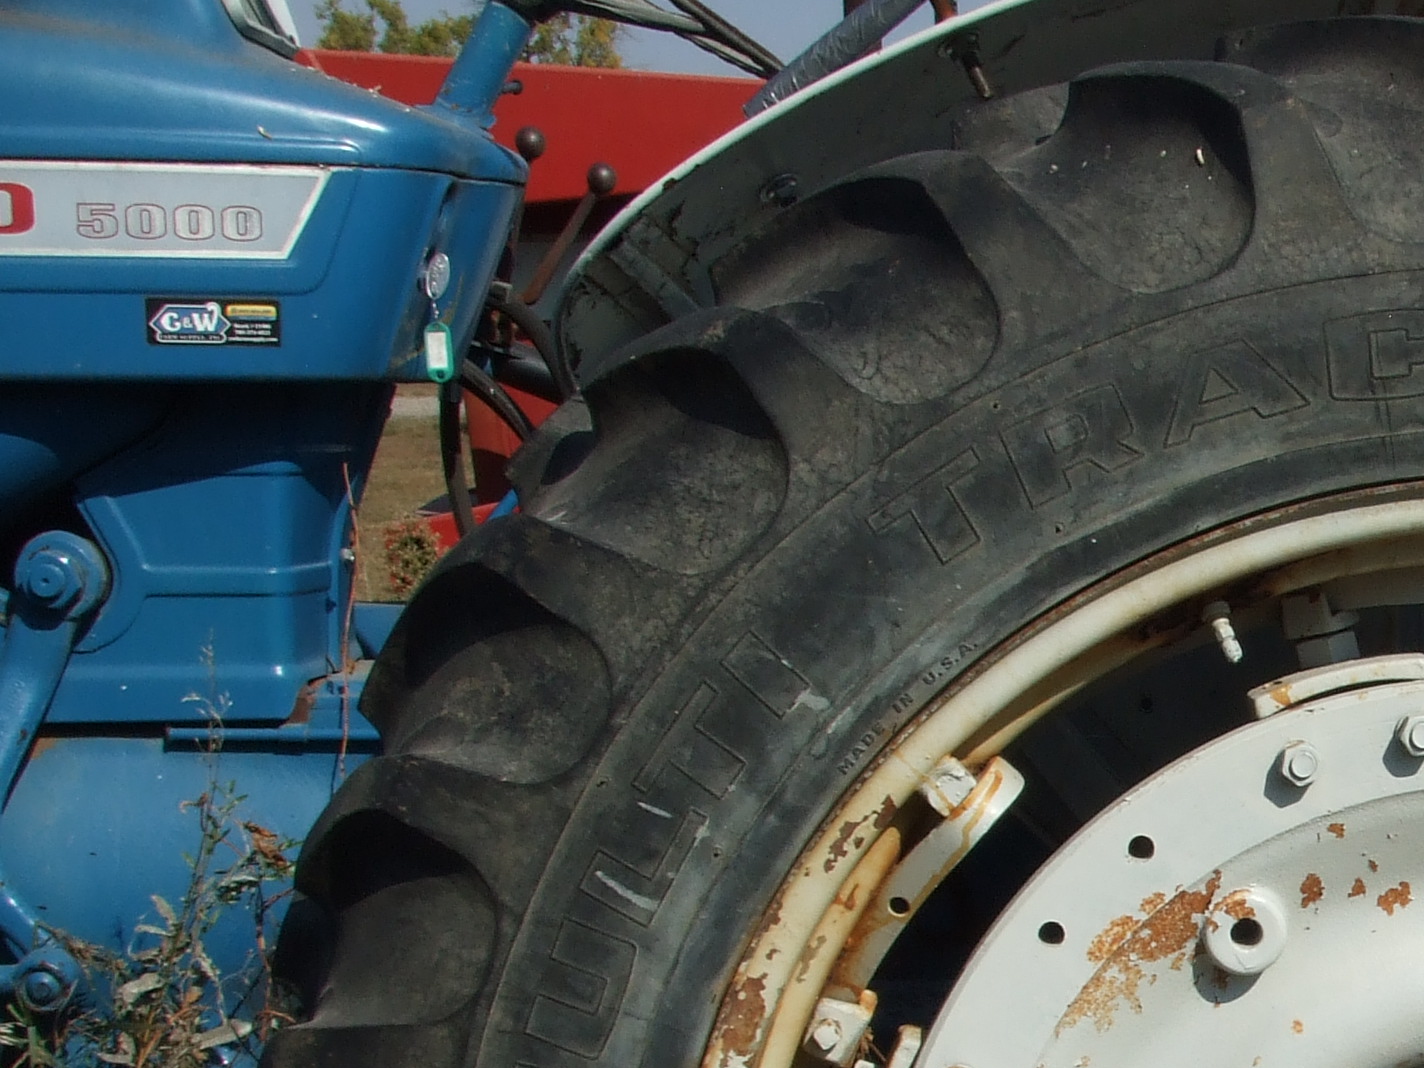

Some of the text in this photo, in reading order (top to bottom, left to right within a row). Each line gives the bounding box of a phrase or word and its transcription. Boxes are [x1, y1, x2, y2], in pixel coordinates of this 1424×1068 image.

[76, 203, 262, 241] 5000
[836, 641, 978, 776] MADE IN U.S.A.
